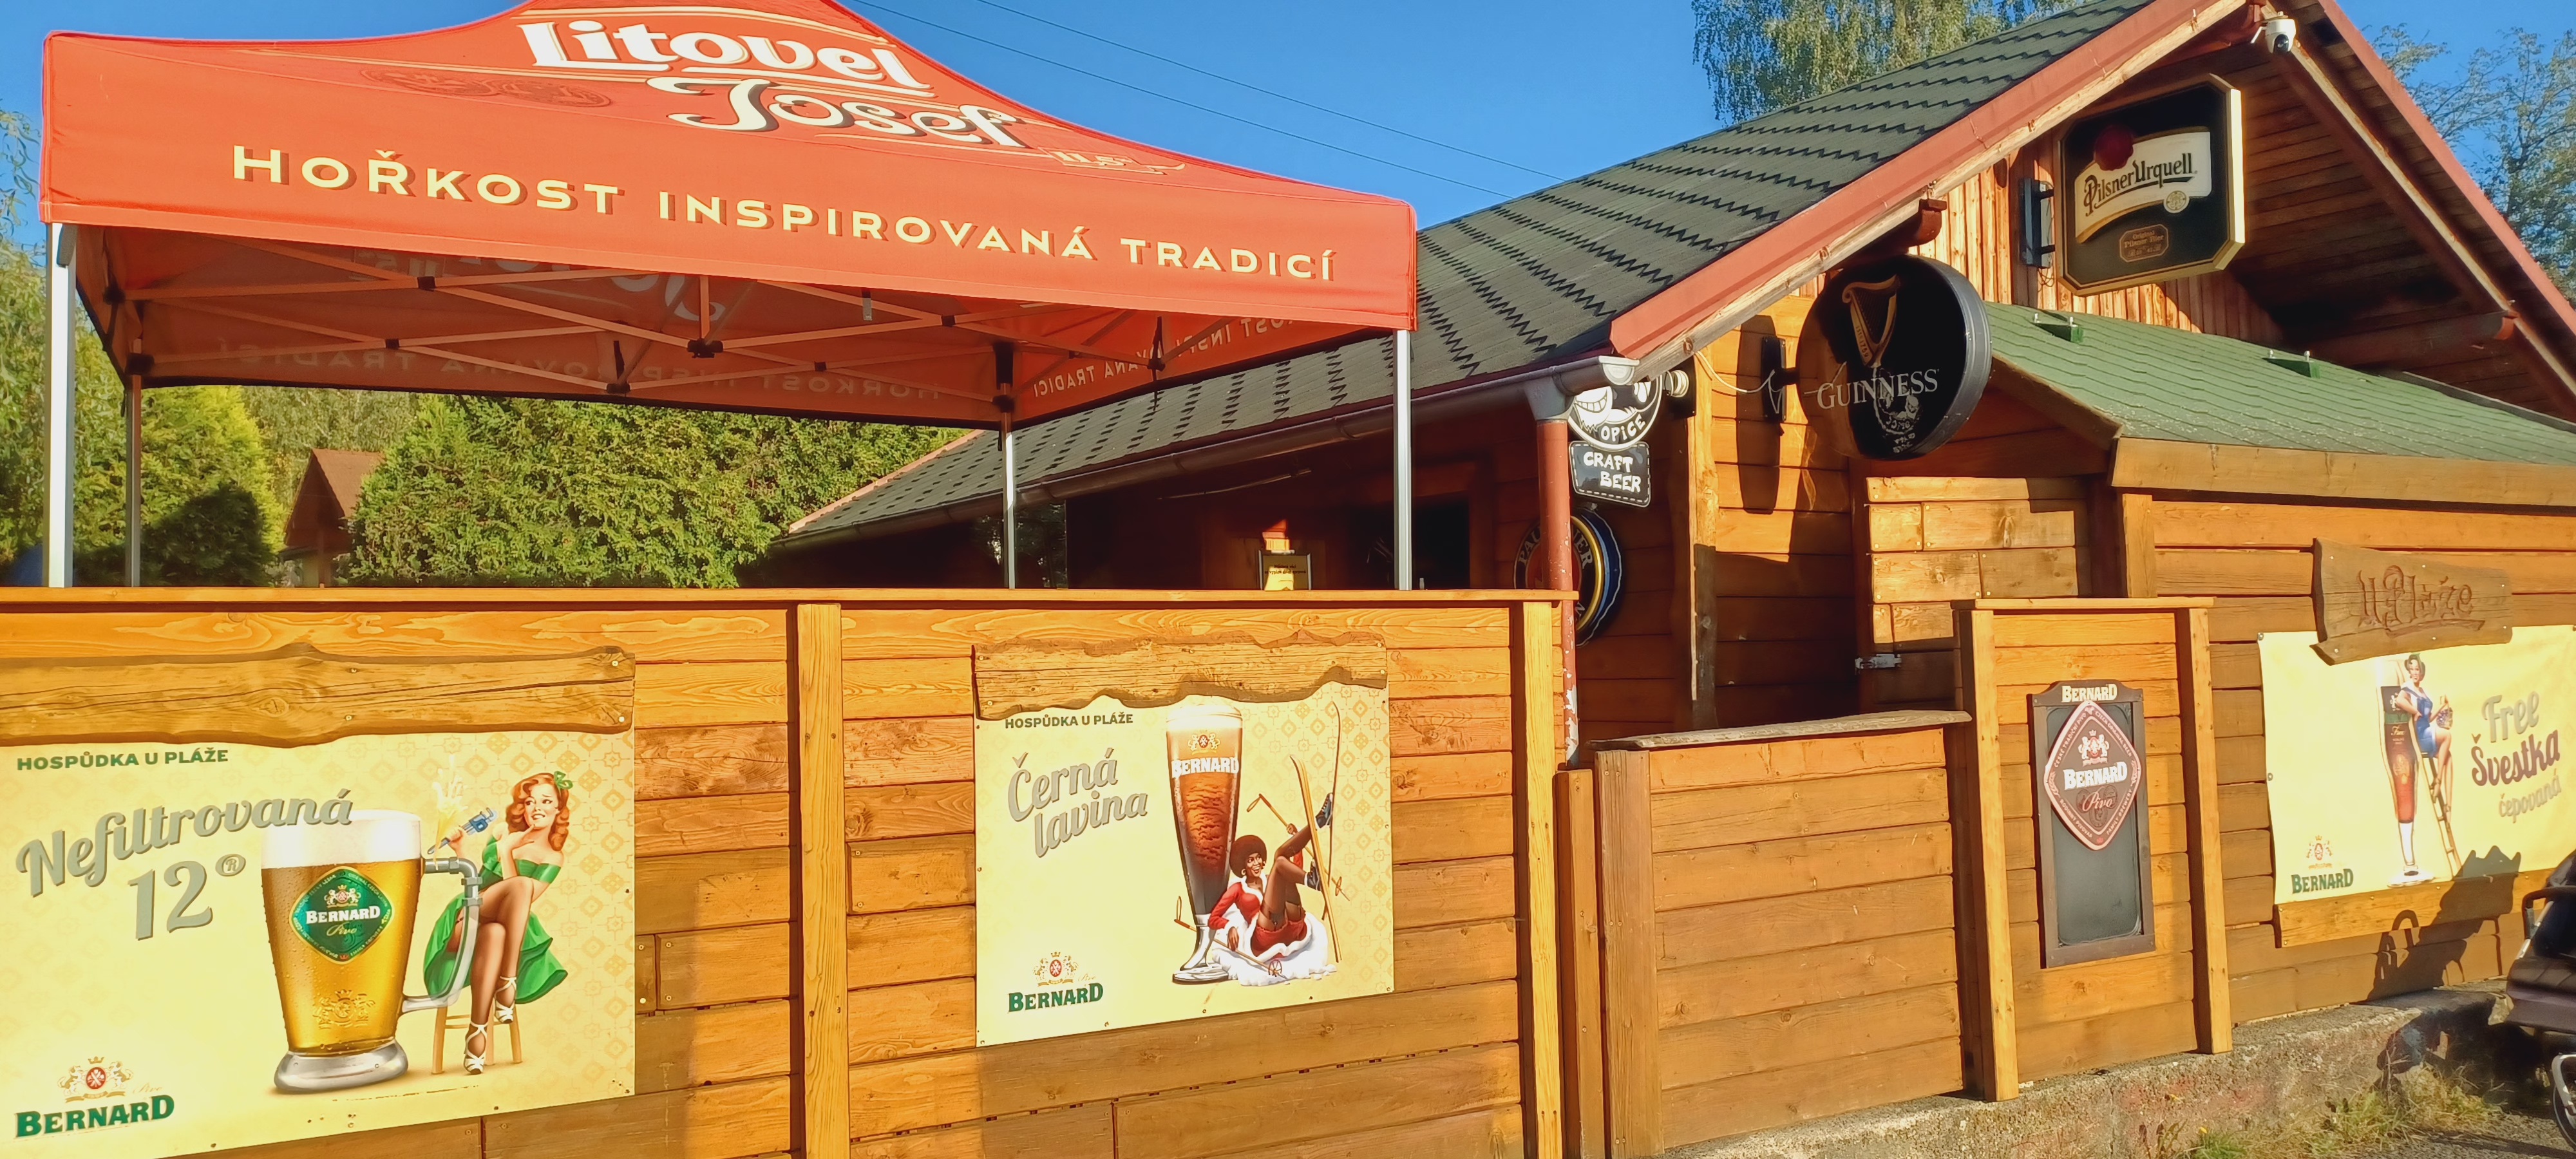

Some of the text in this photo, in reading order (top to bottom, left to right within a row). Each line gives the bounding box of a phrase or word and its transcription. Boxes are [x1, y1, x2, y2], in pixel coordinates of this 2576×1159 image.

[516, 20, 933, 90] Litovel
[646, 77, 1029, 149] Josef
[2083, 152, 2192, 217] Pilsner Urquell
[233, 145, 1336, 281] HOŘKOST INSPIROVANÁ TRADICÍ
[1817, 369, 1938, 410] GUINNESS
[1583, 451, 1634, 473] CRAFT
[1600, 471, 1642, 493] BEER
[2061, 684, 2117, 702] BERNARD
[1005, 711, 1133, 729] HOSPŮDKA U PLÁŽE
[2481, 691, 2539, 743] Free
[17, 747, 229, 771] HOSPŮDKA U PLÁŽE
[1171, 757, 1240, 779] BERNARD
[2063, 761, 2127, 790] BERNARD
[2471, 730, 2560, 786] Švestka
[1007, 747, 1119, 823] Černá
[2082, 786, 2113, 811] Pivo
[2499, 768, 2562, 824] čepovaná
[1034, 786, 1148, 858] lavina
[15, 788, 354, 898] Nefiltrovaná
[2291, 868, 2354, 895] BERNARD
[306, 905, 381, 925] BERNARD
[327, 921, 357, 936] Pivo
[1007, 982, 1104, 1013] BERNARD
[14, 1095, 175, 1139] BERNARD
